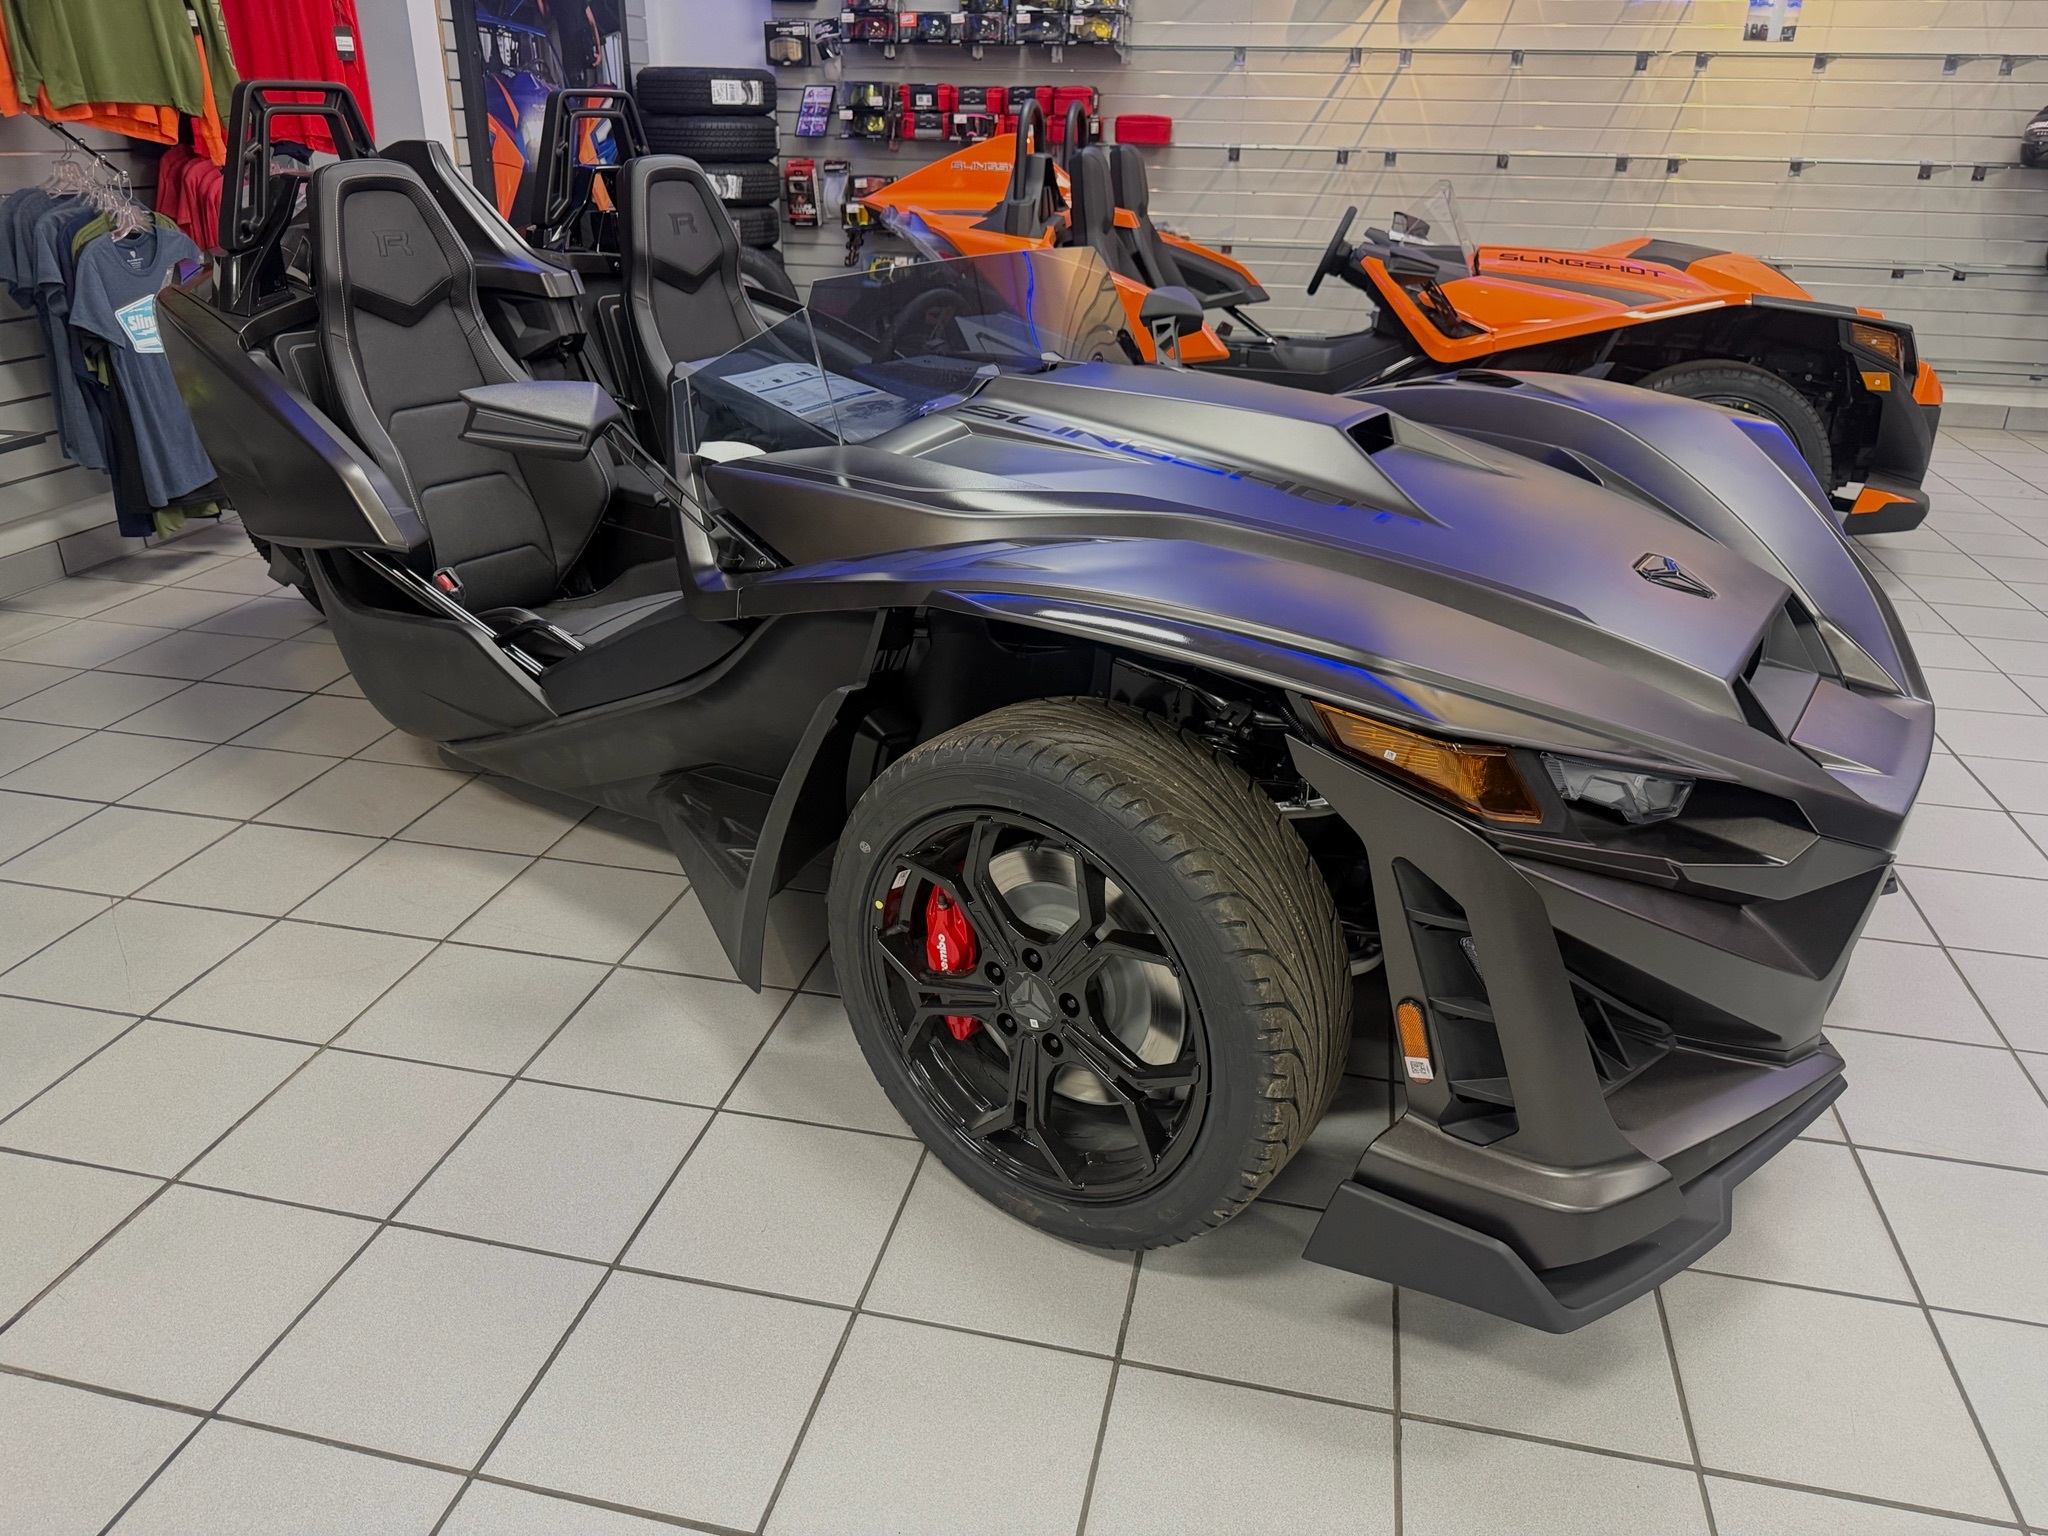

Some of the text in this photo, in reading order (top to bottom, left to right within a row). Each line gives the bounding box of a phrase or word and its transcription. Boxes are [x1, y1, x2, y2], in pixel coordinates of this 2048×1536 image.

[1499, 253, 1667, 277] SLINGSHOT
[127, 314, 157, 332] Slin
[956, 405, 1423, 526] SLINGSHOT
[936, 933, 949, 971] embo
